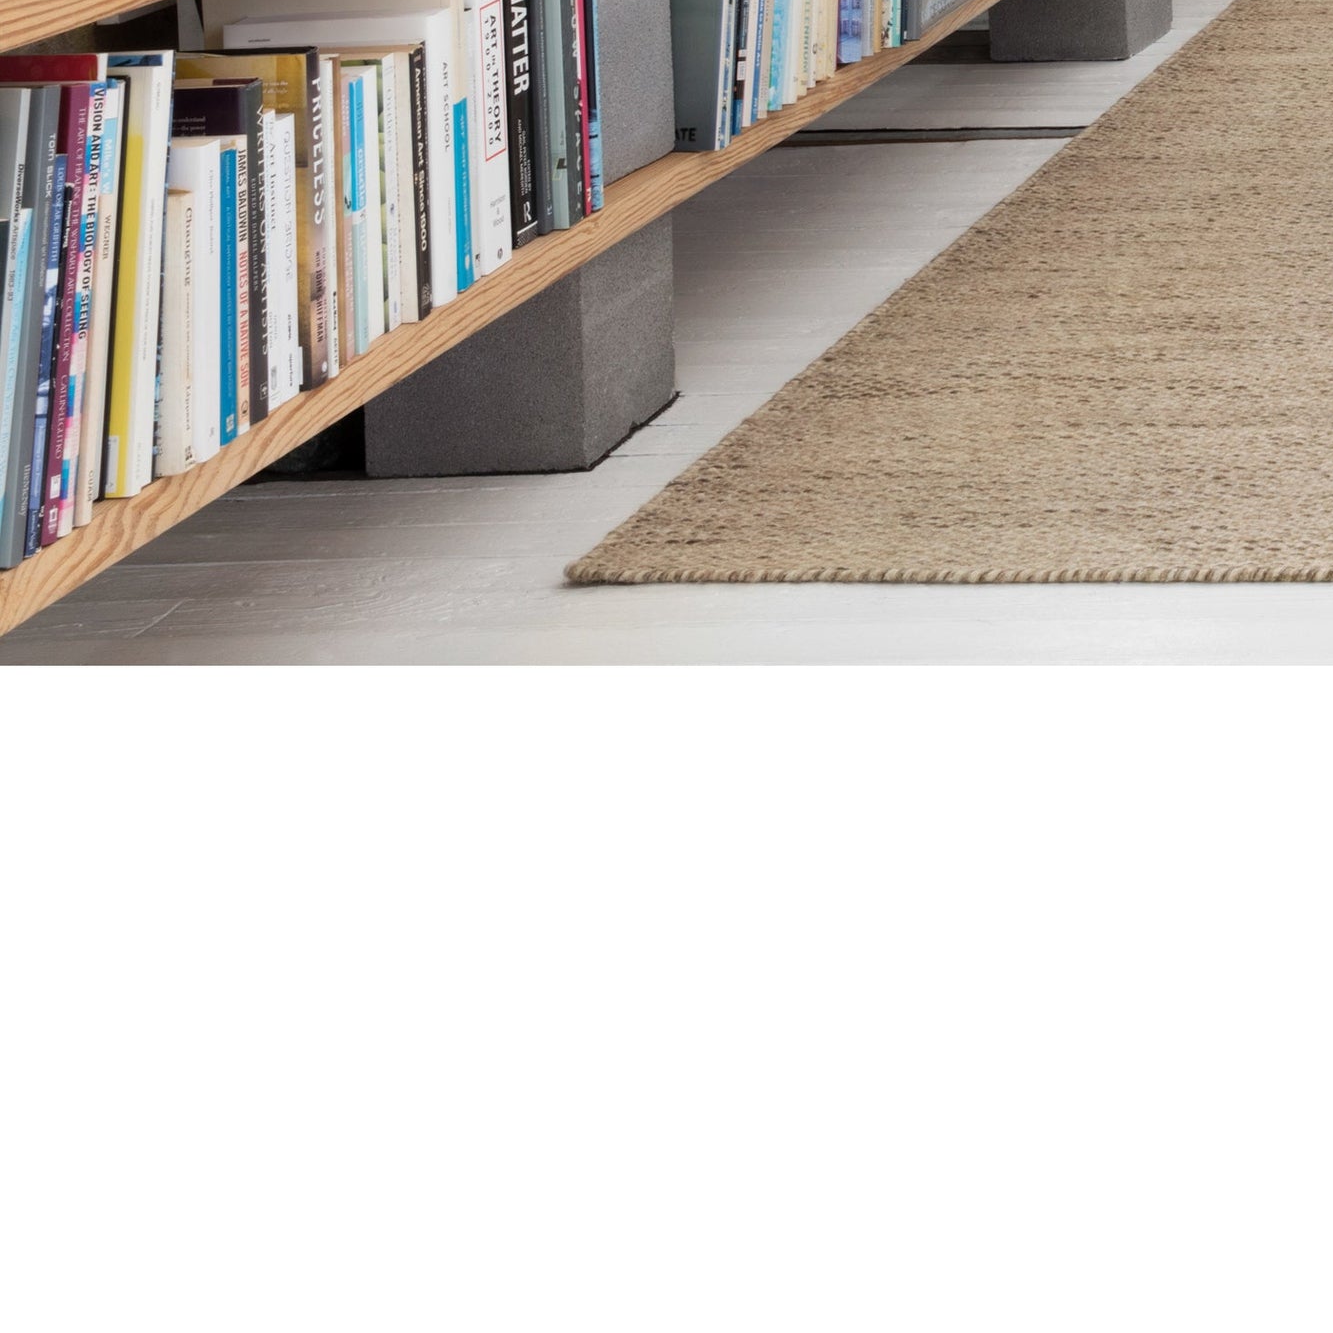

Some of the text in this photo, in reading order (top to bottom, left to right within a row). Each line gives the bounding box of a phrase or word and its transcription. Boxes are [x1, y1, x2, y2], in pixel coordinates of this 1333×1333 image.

[755, 52, 763, 67] Art
[757, 24, 765, 51] Public
[759, 13, 765, 22] to
[442, 62, 451, 153] ART SCHOOL
[489, 14, 502, 143] ART THEORY
[45, 166, 54, 198] SLICK
[102, 138, 113, 178] Mike's
[268, 142, 279, 231] Art Instinct
[312, 77, 326, 225] PRICELESS
[414, 68, 427, 251] American Art Since 1900
[7, 164, 25, 301] DiverseWorks Artspace 1983-93
[50, 167, 65, 262] LOUIS OSCAR GRIFFITH
[62, 107, 87, 361] THE ART OF THE ART COLLECTION
[78, 88, 105, 340] VISION AND ART: THE BIOLOGY OF SEEING
[102, 215, 112, 260] WEGNER
[184, 207, 193, 286] Changing
[251, 212, 258, 225] BY
[255, 105, 268, 355] WRITERS ON ARTISTS
[282, 131, 294, 282] QUESTION BRIDGE
[237, 148, 250, 388] JAMES BALDWIN NOTES OF A NATIVE SON
[316, 295, 324, 342] SHIFFMAN
